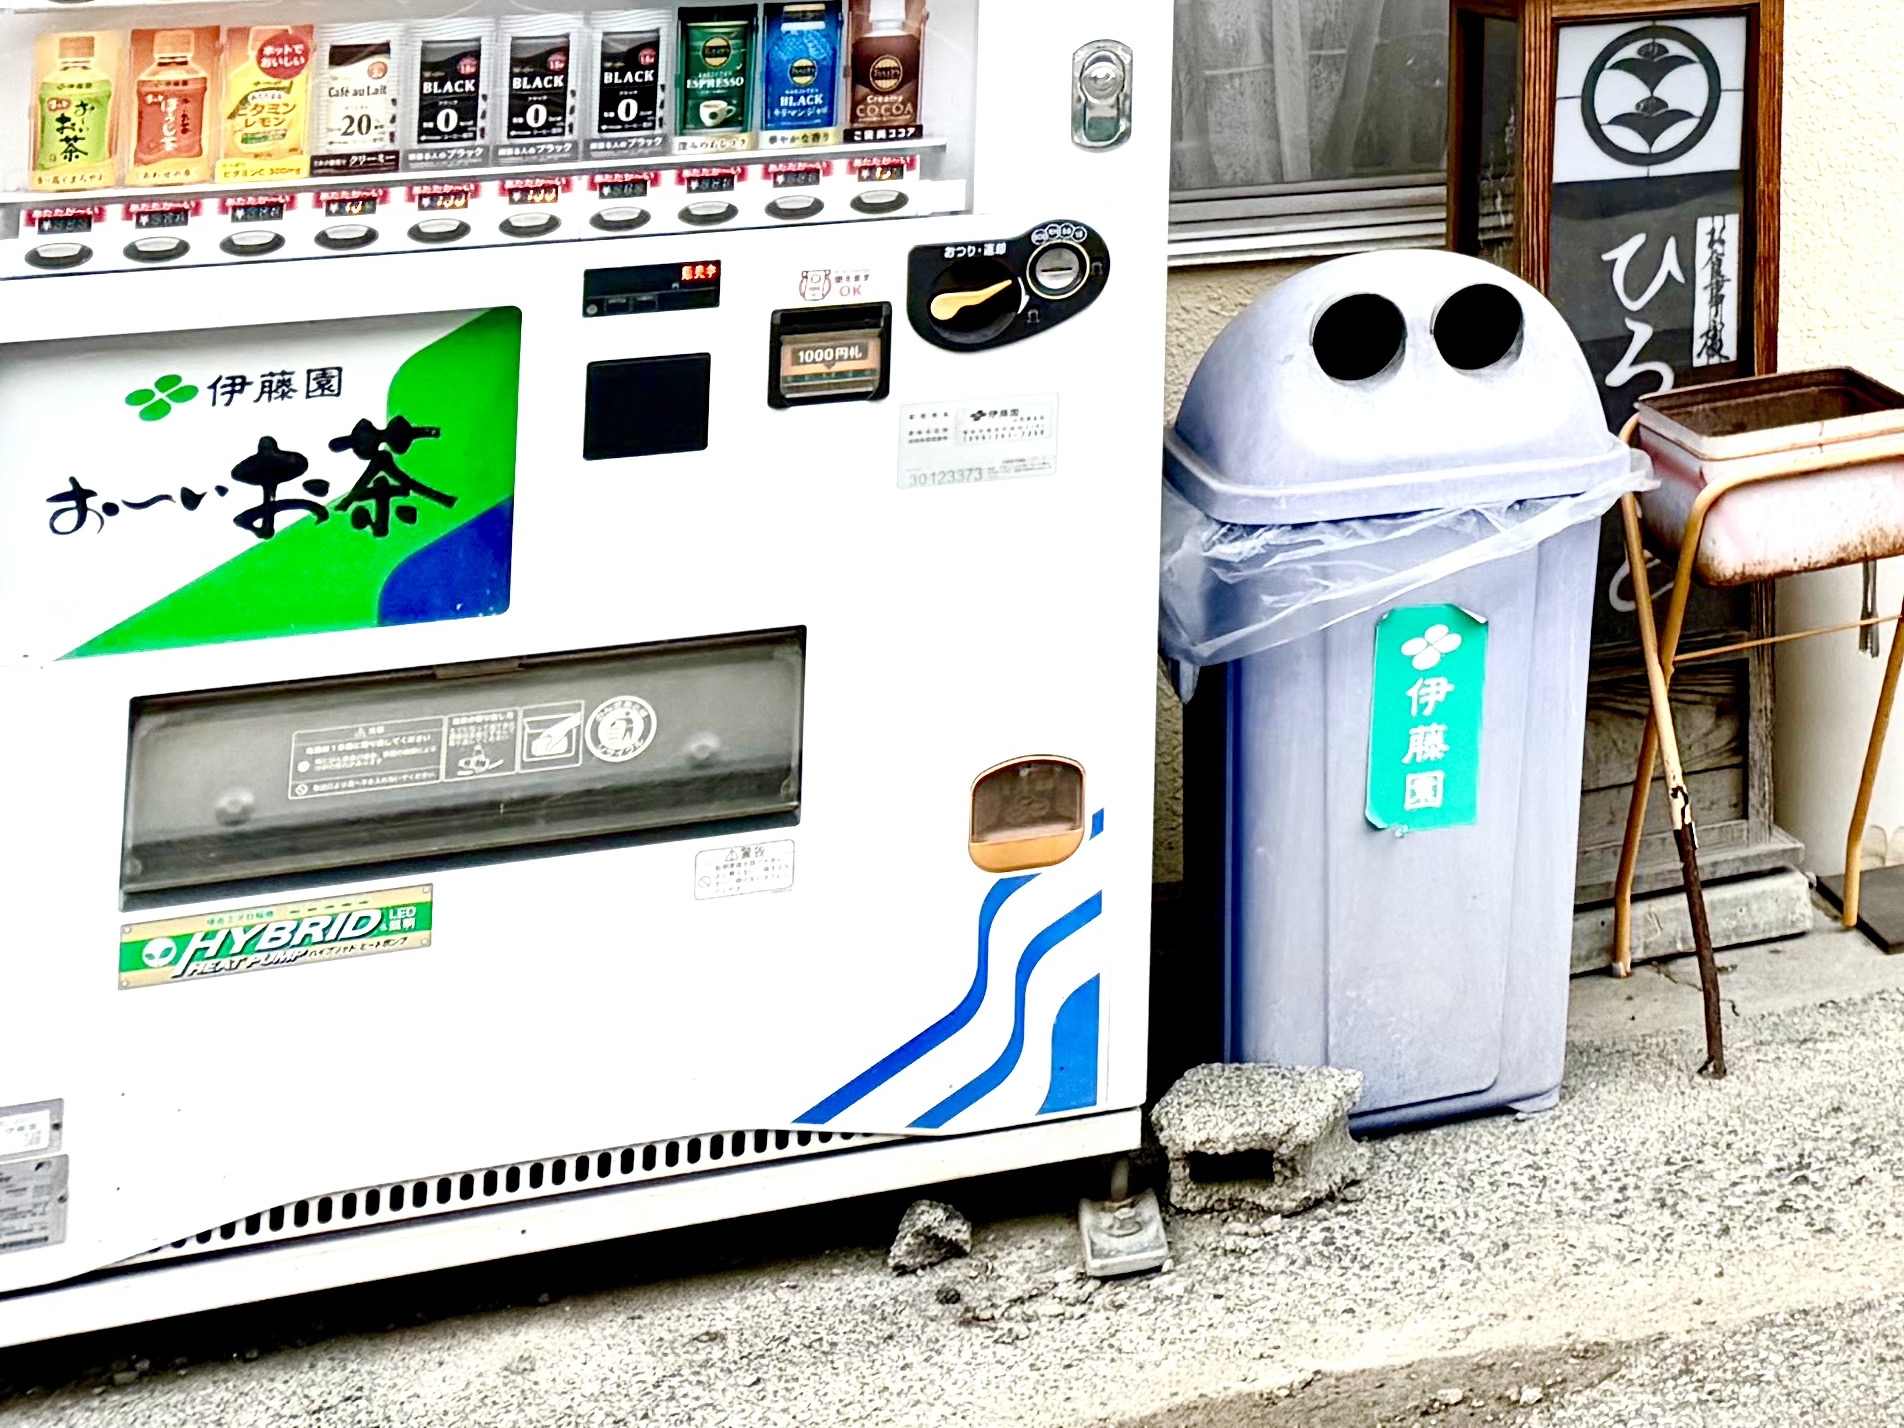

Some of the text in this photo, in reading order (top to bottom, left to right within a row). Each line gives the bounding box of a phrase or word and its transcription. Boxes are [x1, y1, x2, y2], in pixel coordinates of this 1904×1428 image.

[262, 45, 304, 56] ホットで
[261, 55, 306, 68] おいしい
[422, 79, 476, 94] BLACK
[512, 75, 564, 89] BLACK
[603, 70, 655, 84] BLACK
[686, 77, 744, 89] ESPRESSO
[617, 98, 638, 122] 0
[780, 94, 823, 107] BLACK
[526, 103, 547, 128] 0
[856, 103, 914, 118] COCOA
[244, 117, 286, 128] レモン
[339, 112, 372, 137] 20
[436, 108, 458, 133] 0
[56, 113, 88, 163] お茶
[798, 345, 862, 364] 1000円札
[206, 366, 345, 408] 伊藤園
[1401, 676, 1455, 811] 伊藤園
[172, 909, 385, 978] HYBRID
[188, 949, 309, 977] HEAT PUMP
